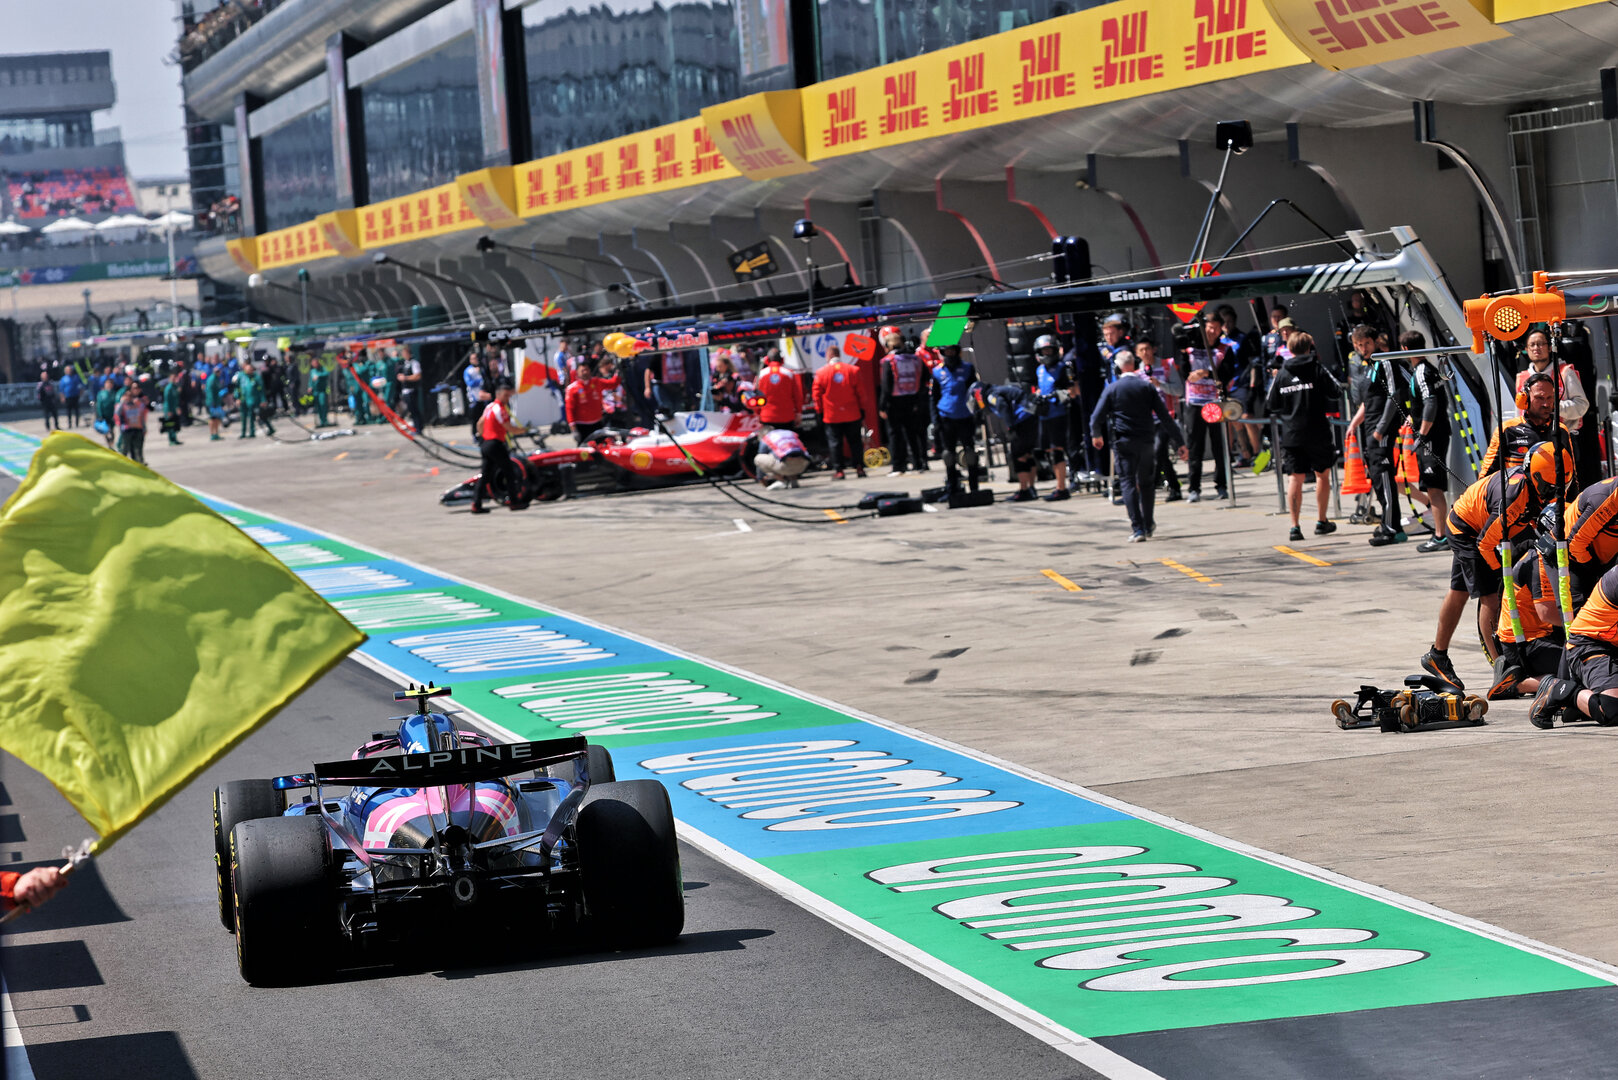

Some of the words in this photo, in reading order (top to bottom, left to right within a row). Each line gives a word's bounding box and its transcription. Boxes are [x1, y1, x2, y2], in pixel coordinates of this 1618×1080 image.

[1093, 10, 1164, 90] DHL
[1185, 0, 1267, 71] DHL
[943, 52, 999, 123] DHL
[1013, 32, 1076, 106] DHL
[822, 86, 868, 148] DHL
[879, 70, 928, 135] DHL
[617, 143, 645, 190] DHL
[653, 134, 683, 184] DHL
[721, 114, 793, 171] DHL
[1109, 286, 1172, 302] Einhell
[658, 337, 682, 349] Red
[683, 332, 708, 346] Bull
[388, 625, 618, 673] aramco
[490, 672, 778, 736] aramco
[370, 742, 532, 774] ALPINE
[638, 739, 1024, 832] aramco
[864, 845, 1431, 993] aramco
